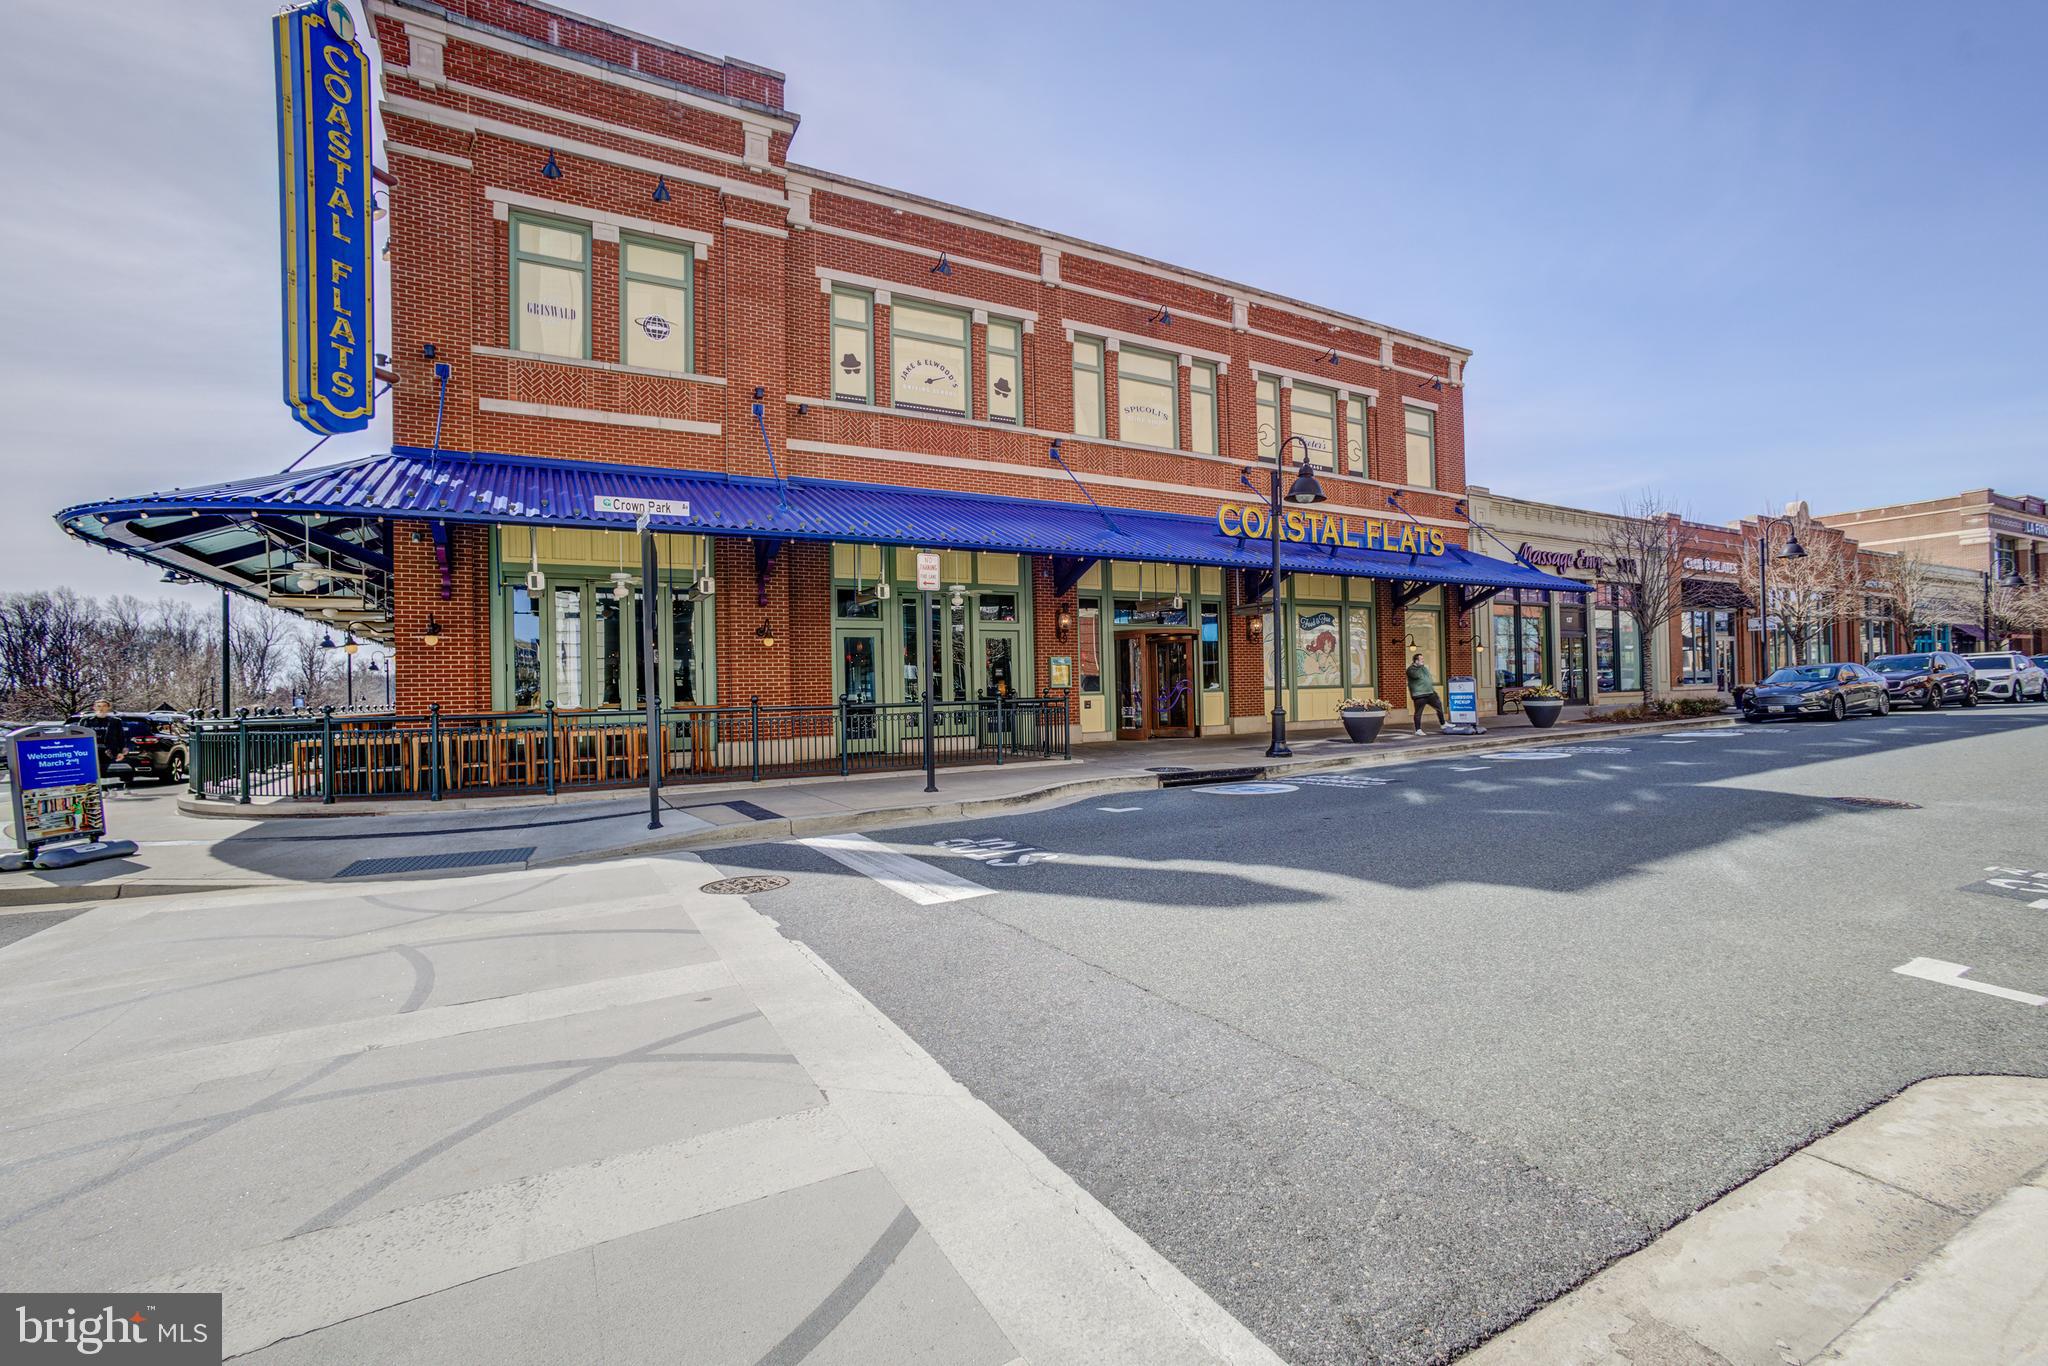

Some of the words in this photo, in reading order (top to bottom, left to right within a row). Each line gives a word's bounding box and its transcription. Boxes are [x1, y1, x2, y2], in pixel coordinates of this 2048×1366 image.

[323, 45, 354, 244] COASTAL
[527, 301, 577, 320] GRISWALD
[331, 257, 356, 399] FLATS
[901, 362, 916, 381] JAKE
[1123, 405, 1169, 421] SPICOLI'S
[613, 498, 645, 512] Crown
[648, 501, 672, 514] Park
[1217, 503, 1360, 549] COASTAL
[1364, 519, 1446, 558] FLATS
[1519, 541, 1574, 576] Massage
[1574, 548, 1605, 578] Envy
[27, 751, 73, 761] Welcoming
[39, 759, 65, 768] March
